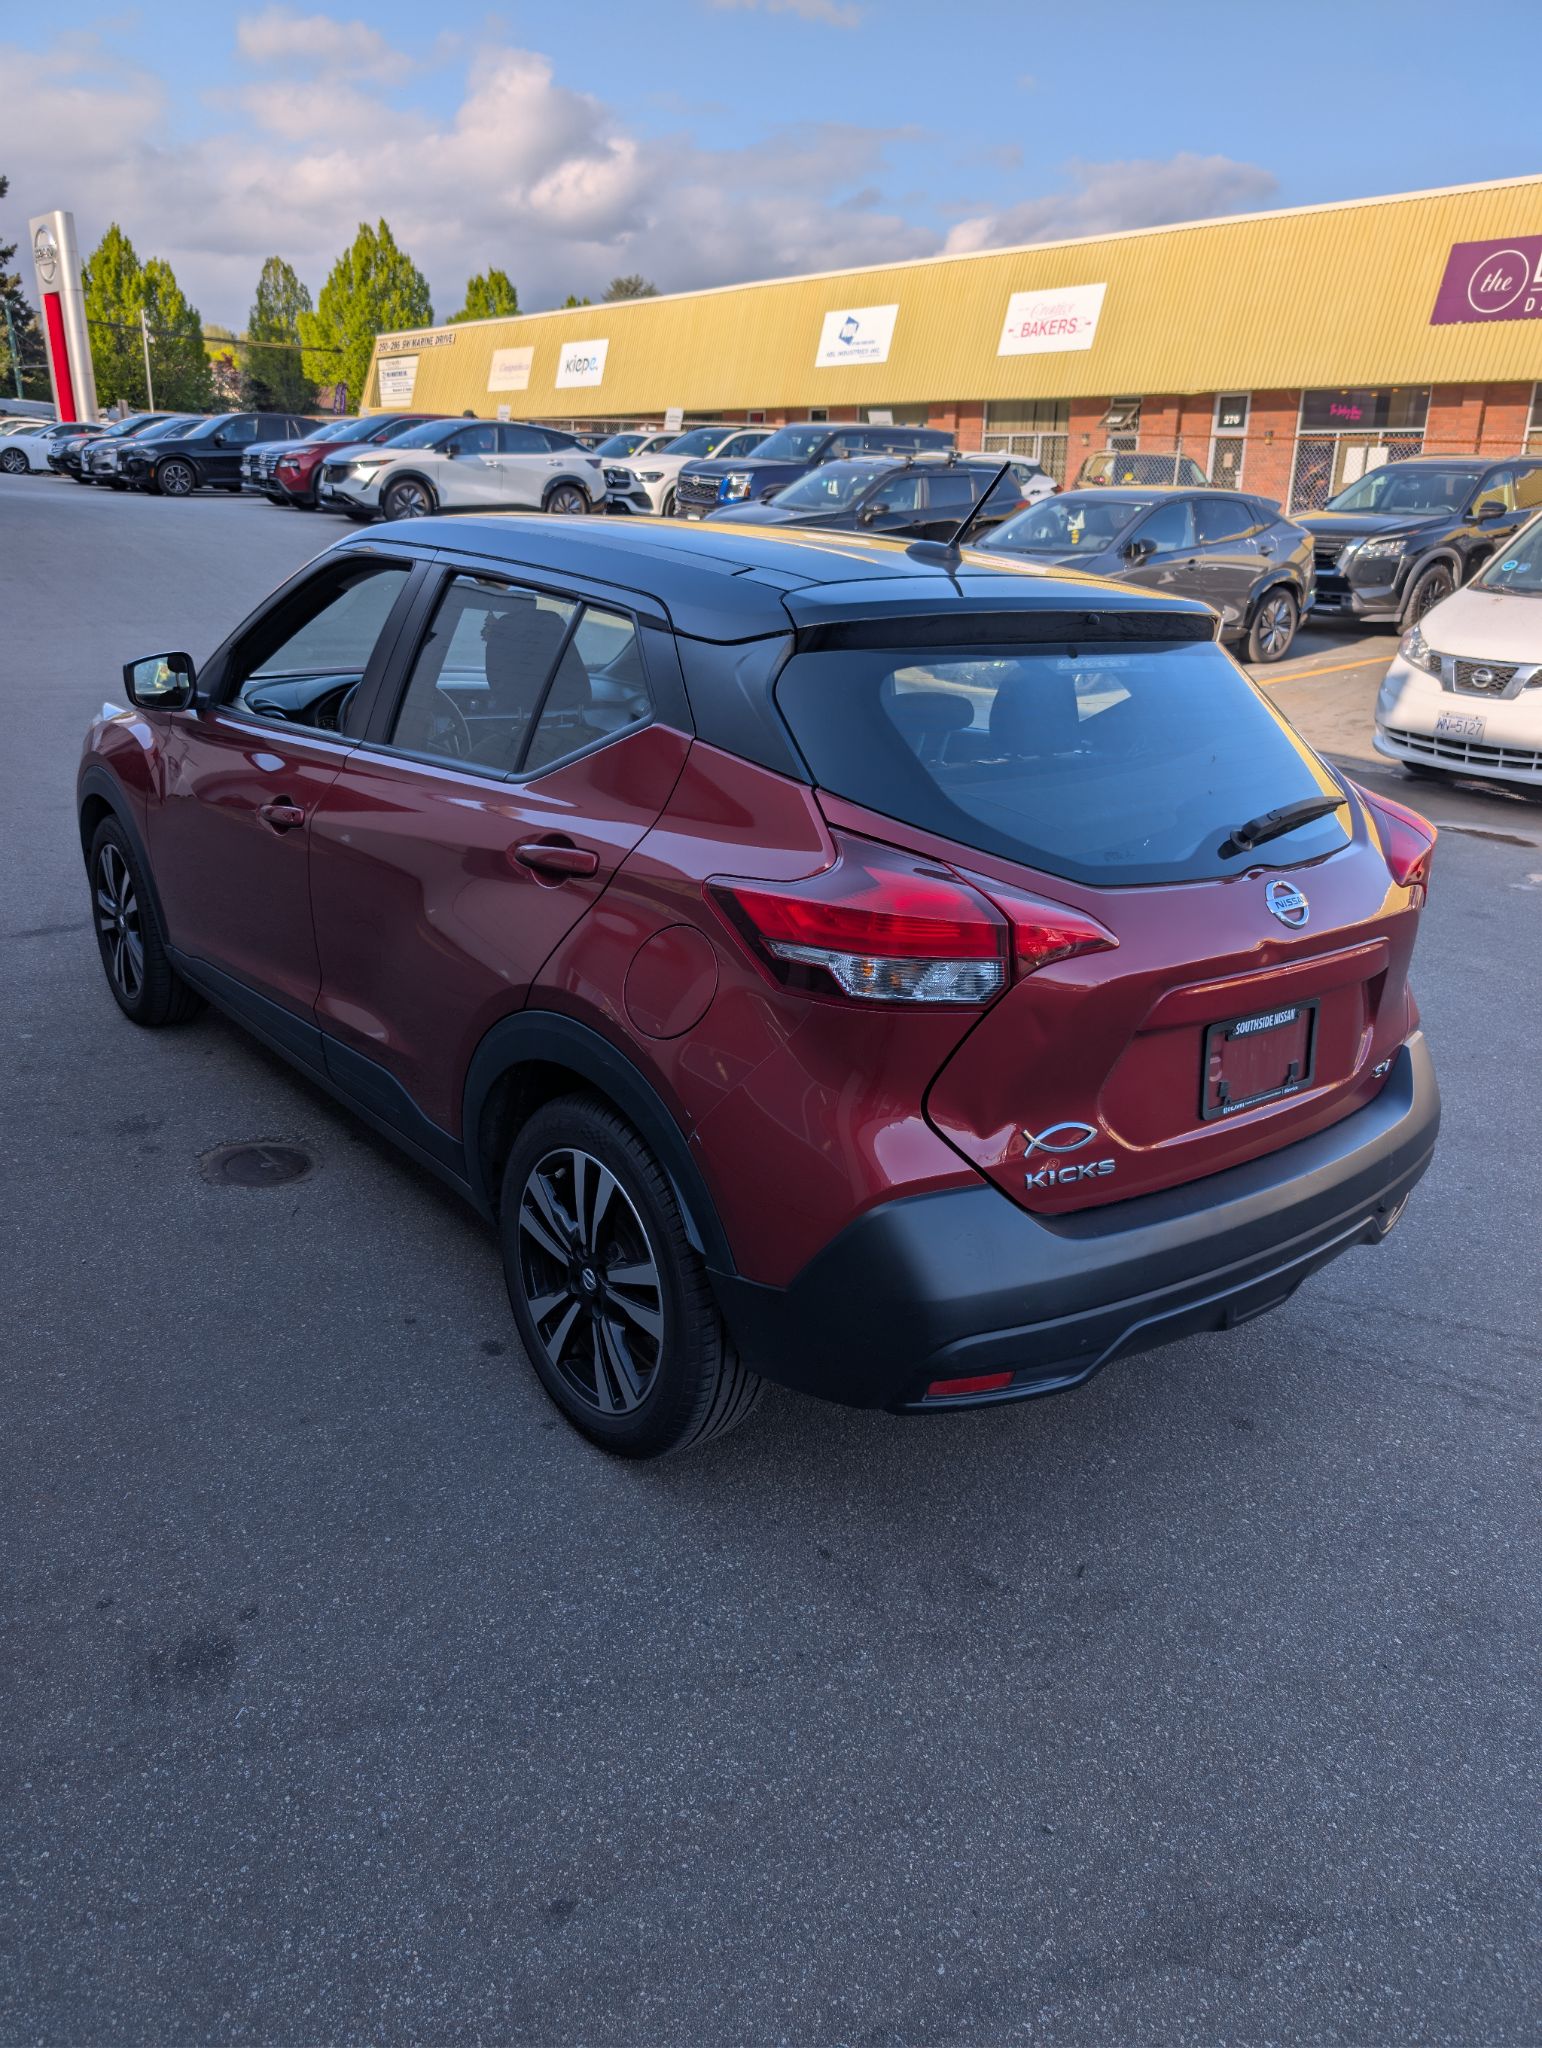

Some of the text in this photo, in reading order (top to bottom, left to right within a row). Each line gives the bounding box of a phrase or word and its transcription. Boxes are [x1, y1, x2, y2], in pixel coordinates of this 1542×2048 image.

[1480, 268, 1513, 293] the
[1020, 317, 1078, 338] BAKERS
[412, 335, 434, 348] MARINE
[434, 333, 453, 345] DRIVE
[1275, 896, 1304, 909] NISSA
[1235, 1007, 1296, 1036] SOUTHSIDE NISSAN
[1024, 1159, 1115, 1190] KICKS
